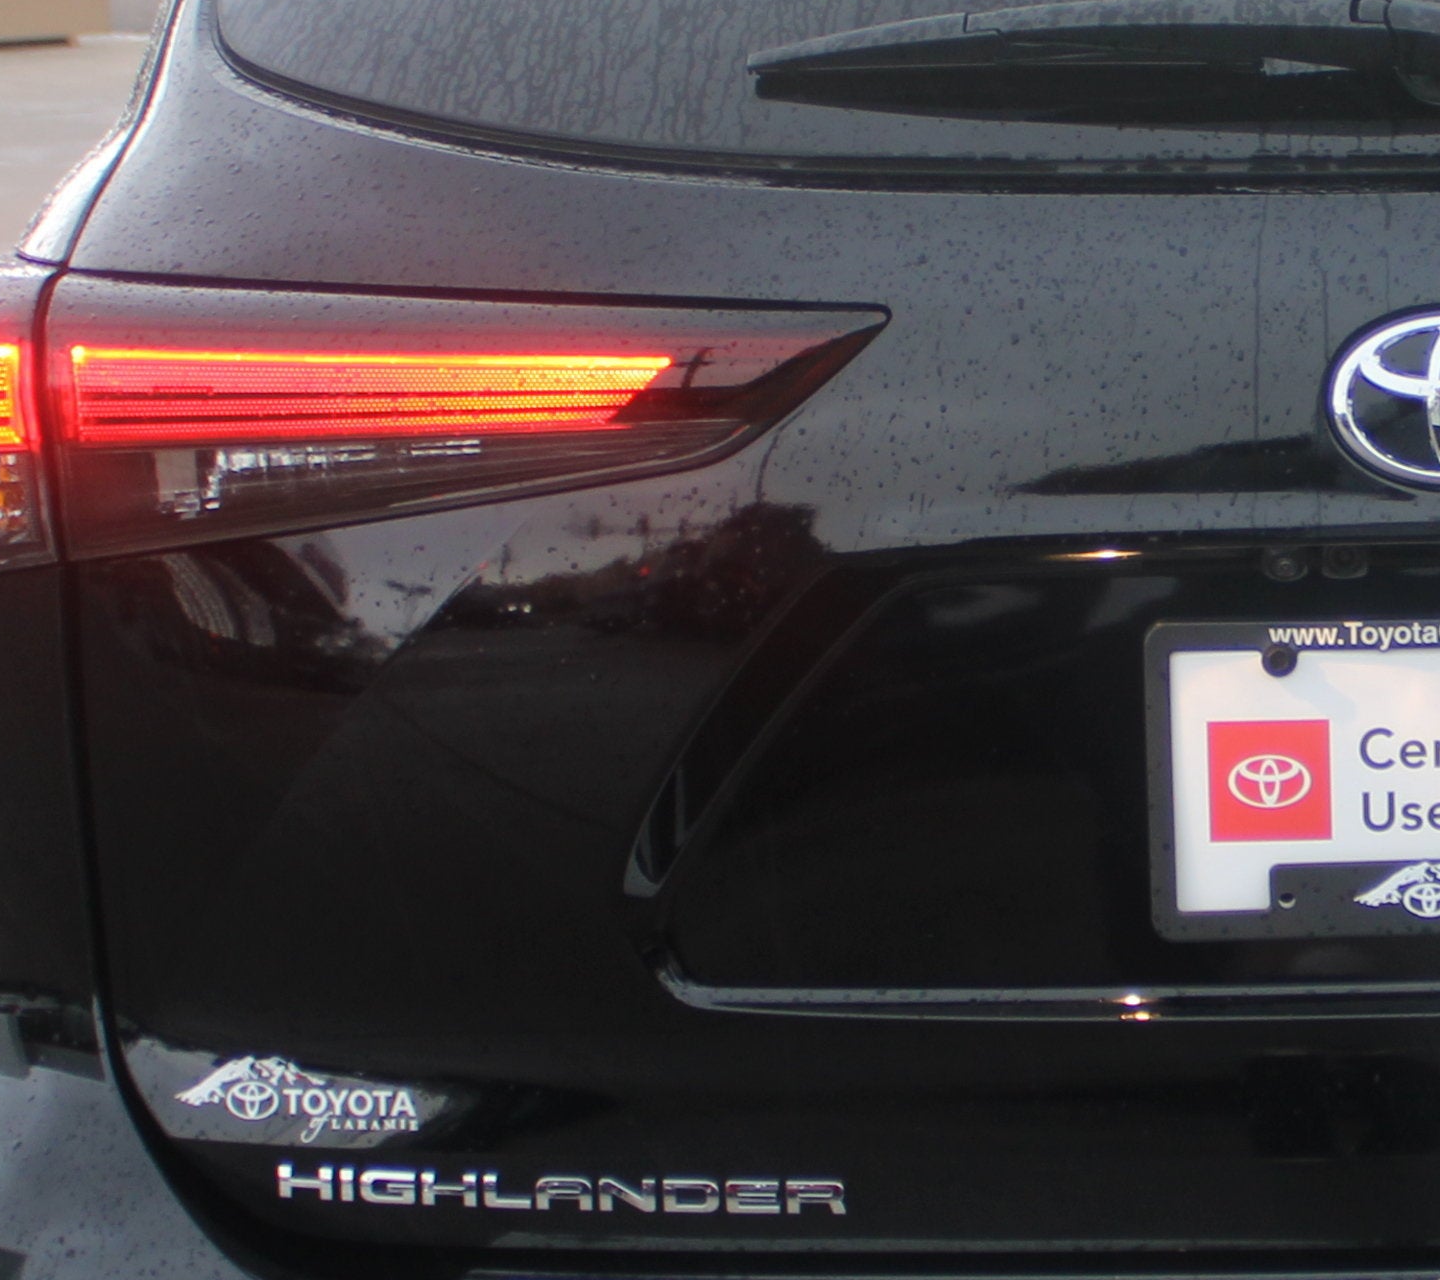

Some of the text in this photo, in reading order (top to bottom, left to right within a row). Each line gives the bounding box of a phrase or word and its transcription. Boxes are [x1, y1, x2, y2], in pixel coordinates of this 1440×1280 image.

[282, 1088, 417, 1117] TOYOTA
[331, 1118, 420, 1132] LARAMIE
[277, 1162, 848, 1216] HIGHLANDER
